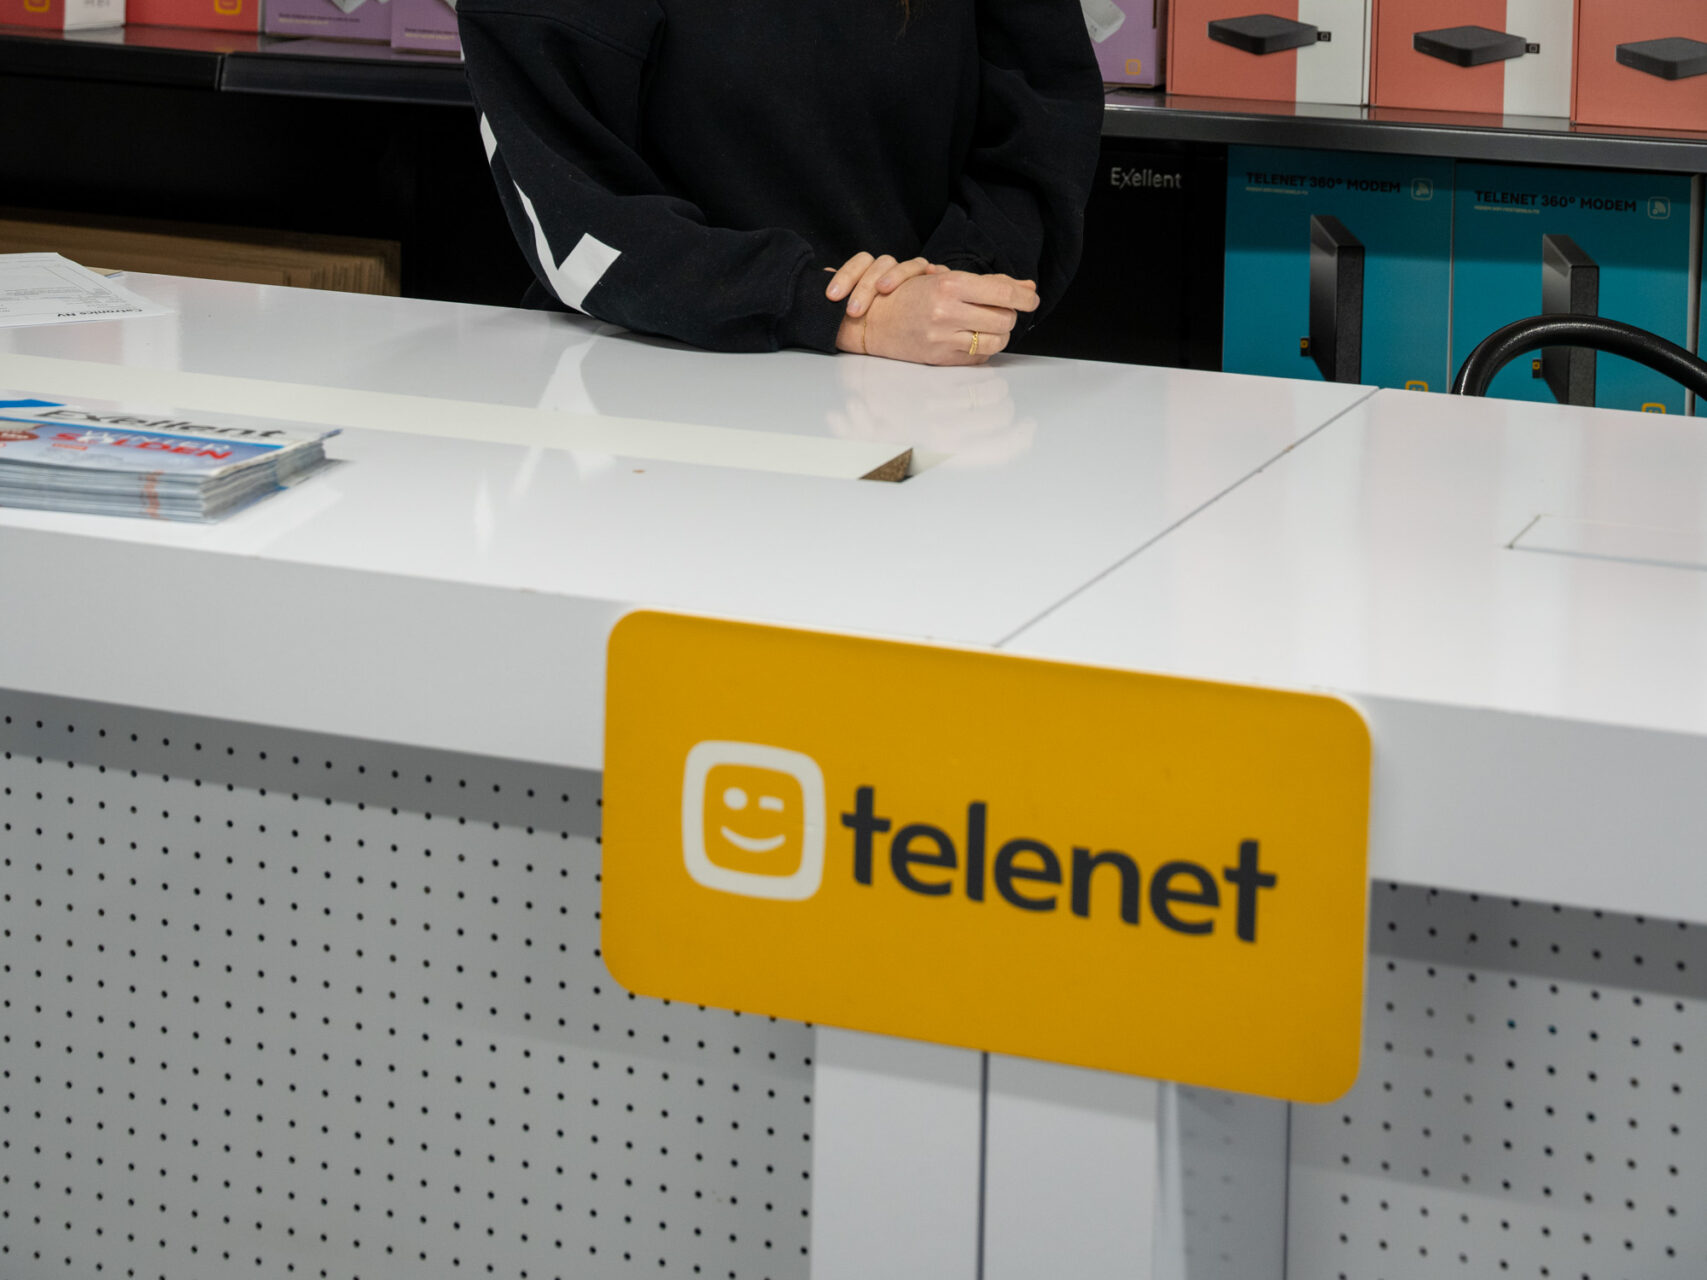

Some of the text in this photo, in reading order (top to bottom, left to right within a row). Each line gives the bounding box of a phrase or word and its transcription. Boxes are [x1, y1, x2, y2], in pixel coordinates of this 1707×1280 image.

[1110, 167, 1182, 190] Exellent
[1245, 171, 1307, 187] TELENET
[1346, 178, 1401, 193] MODEM
[1474, 189, 1537, 206] TELENET
[1580, 197, 1637, 212] MODEM
[840, 785, 1278, 944] telenet
